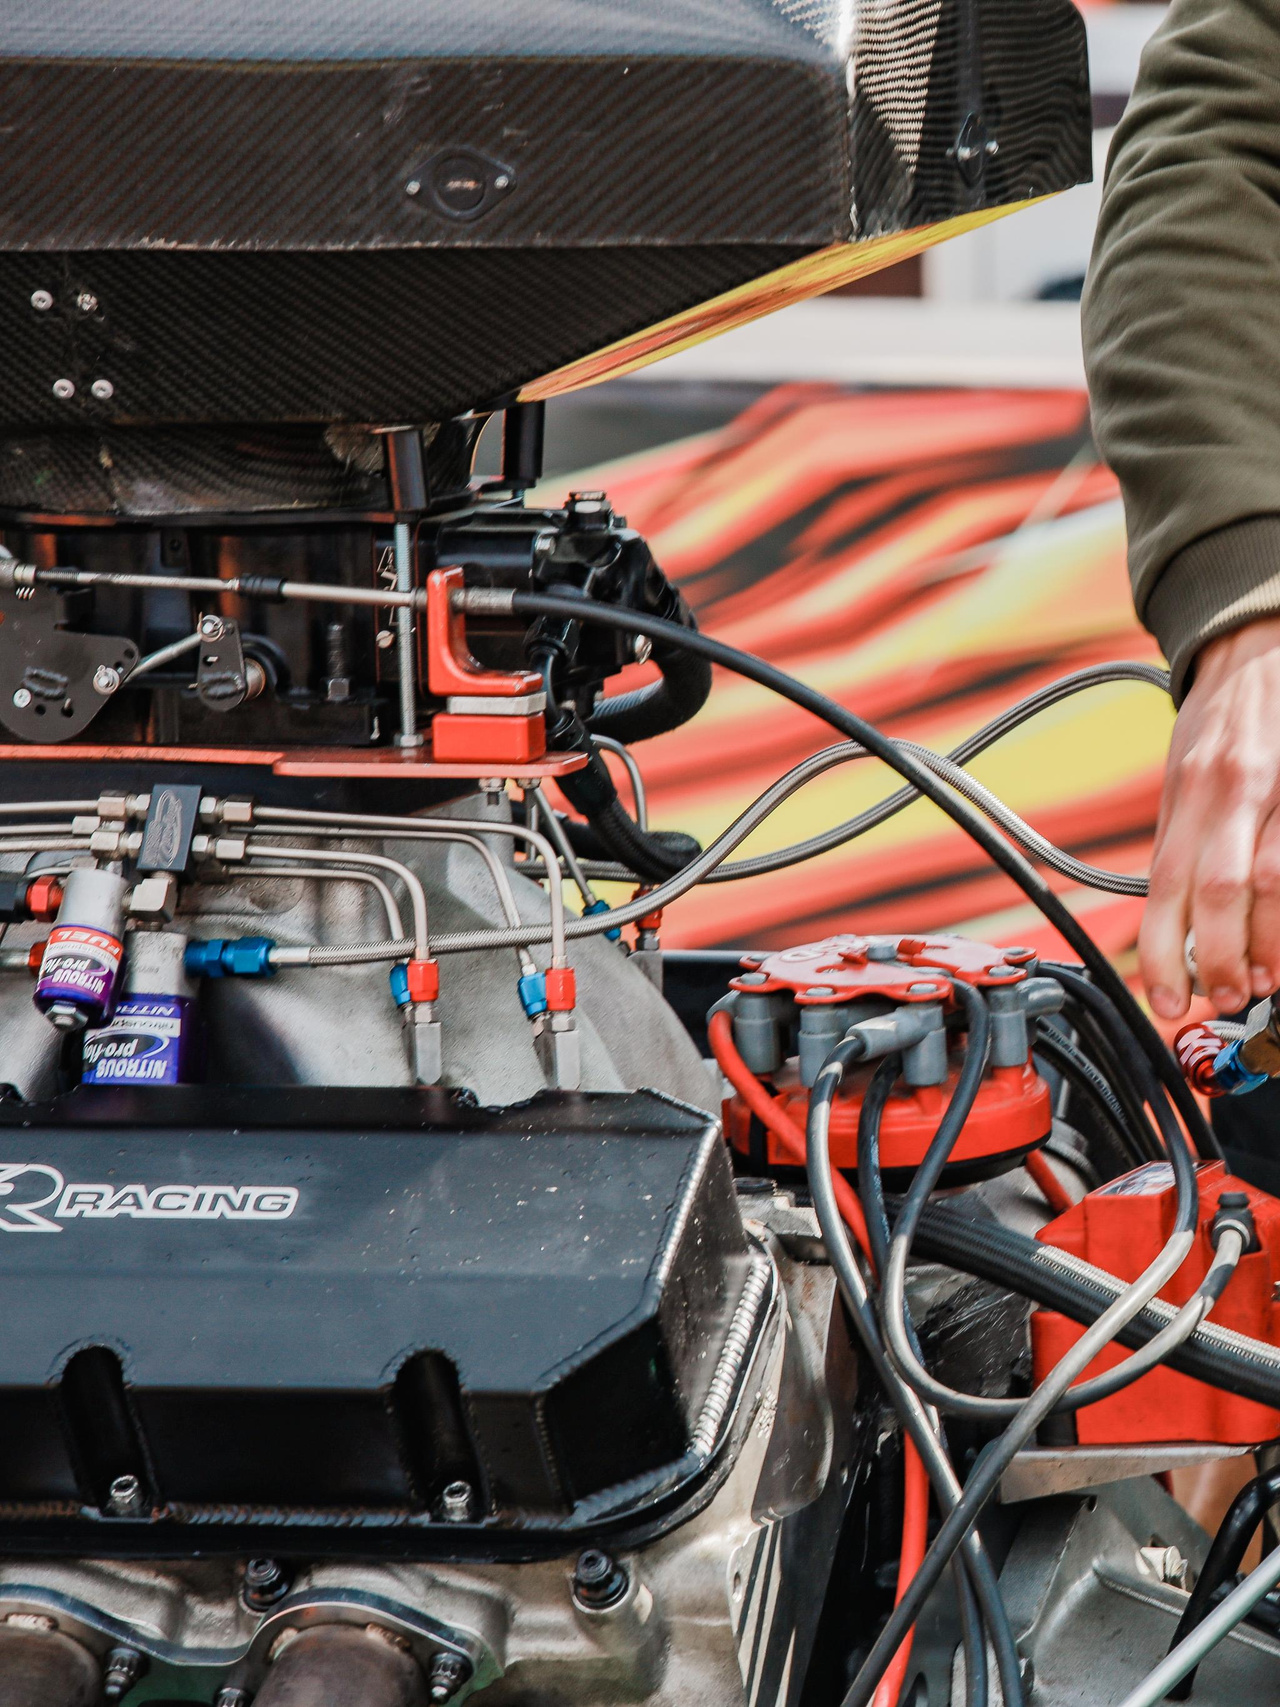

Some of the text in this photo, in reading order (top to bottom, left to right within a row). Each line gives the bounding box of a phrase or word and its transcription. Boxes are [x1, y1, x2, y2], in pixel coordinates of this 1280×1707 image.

[57, 930, 120, 955] FUEL
[52, 968, 106, 995] NITROUS
[96, 1058, 168, 1079] NITROUS
[54, 1183, 299, 1220] RACING
